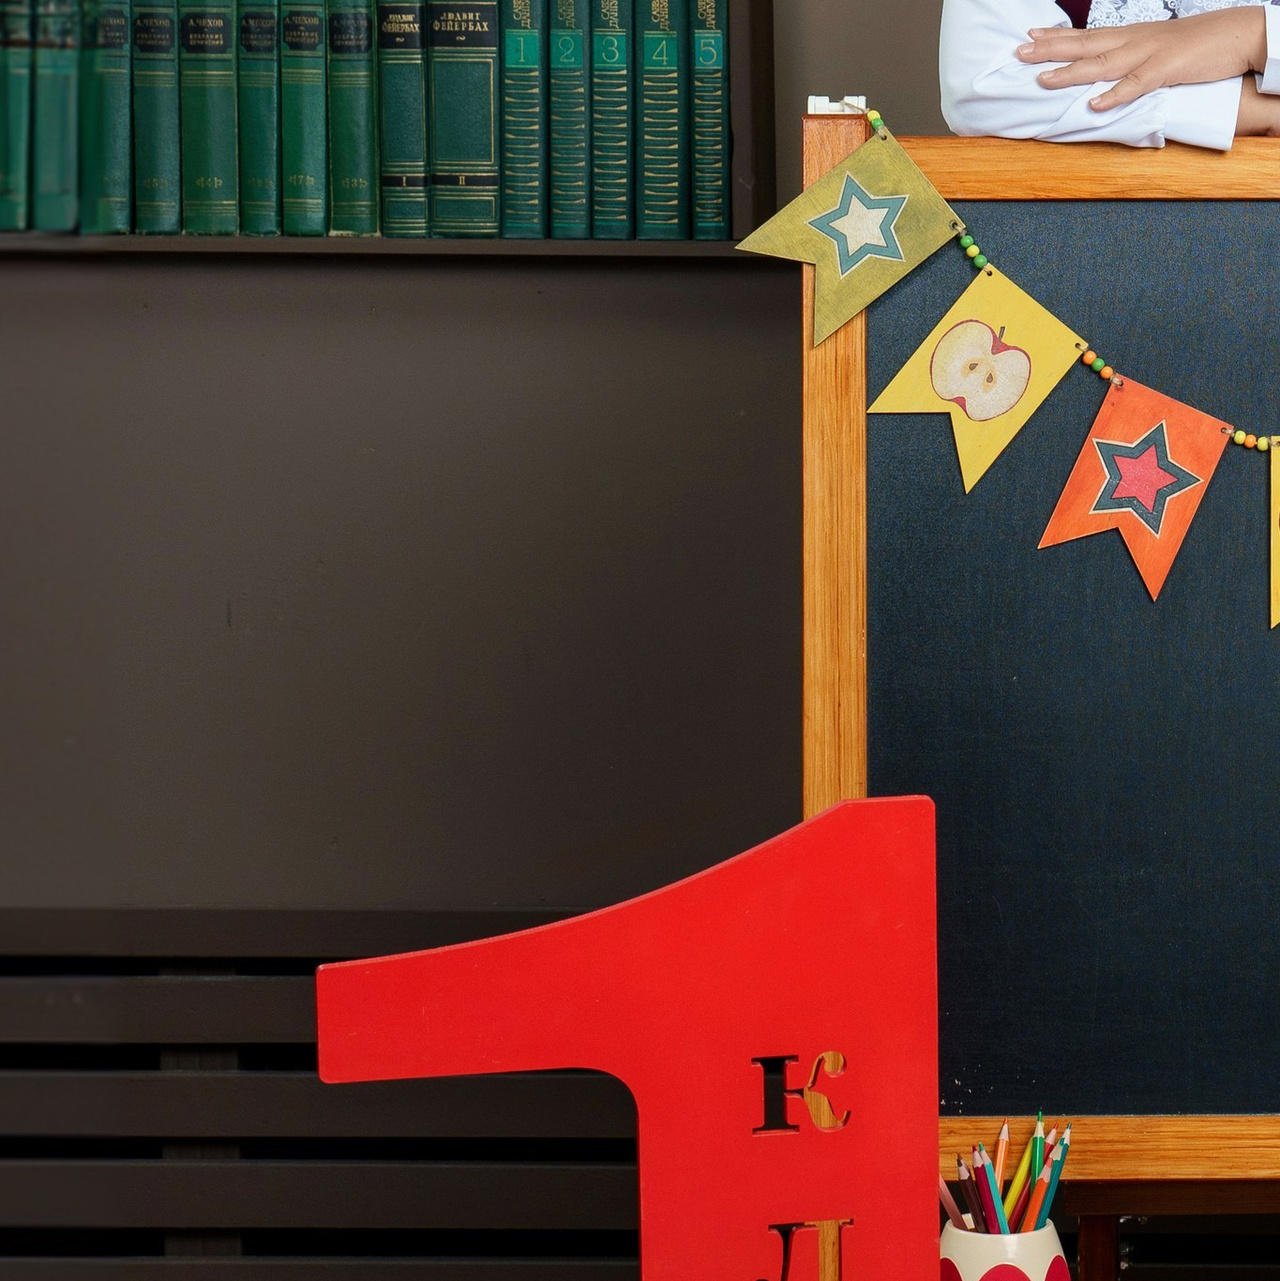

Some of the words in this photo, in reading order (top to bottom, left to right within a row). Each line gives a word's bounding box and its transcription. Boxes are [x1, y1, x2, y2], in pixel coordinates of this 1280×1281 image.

[517, 37, 525, 62] 1
[558, 36, 575, 62] 2
[602, 36, 619, 62] 3
[652, 39, 668, 65] 4
[699, 39, 717, 65] 5
